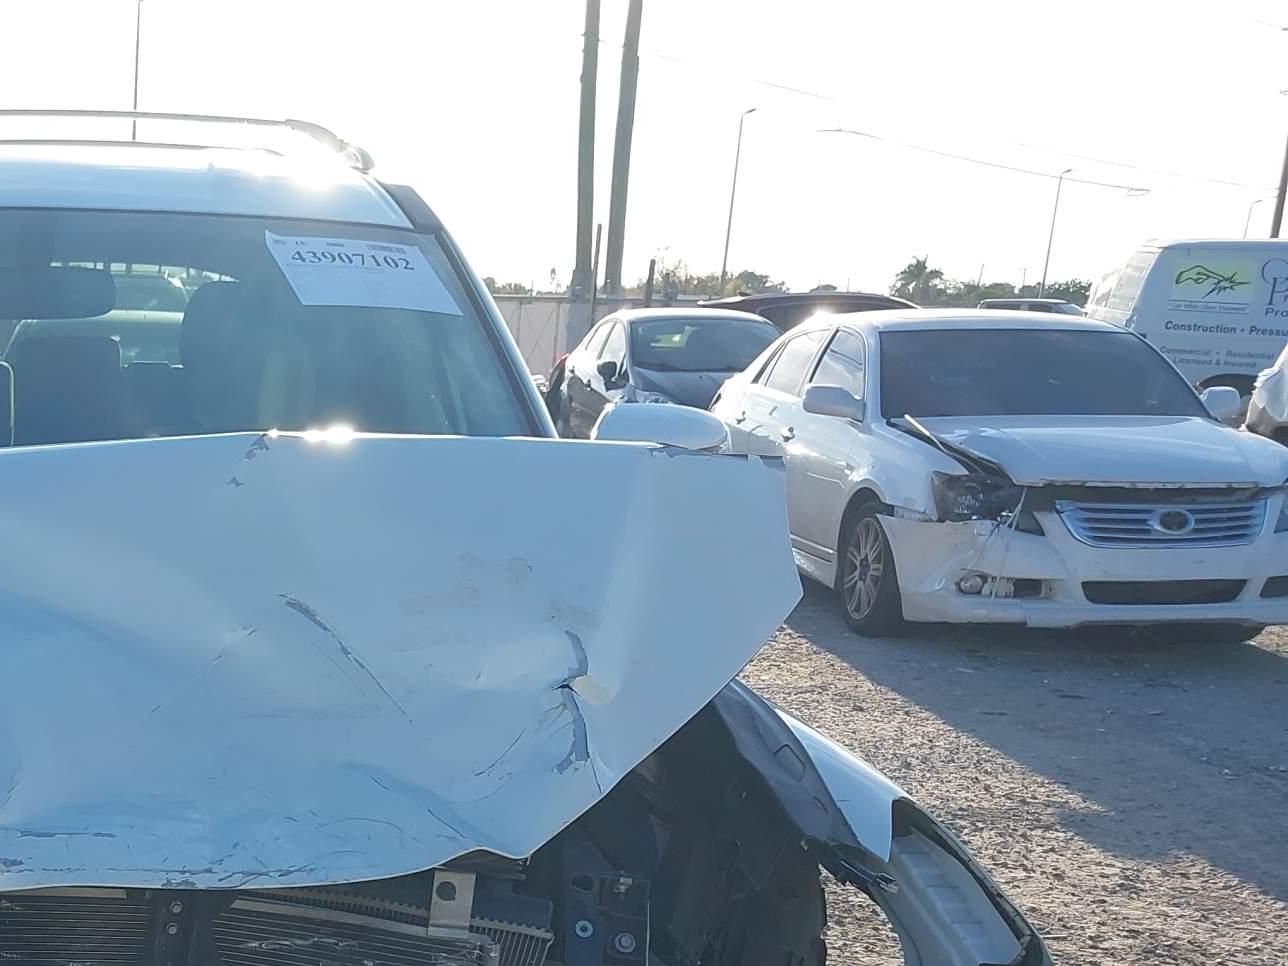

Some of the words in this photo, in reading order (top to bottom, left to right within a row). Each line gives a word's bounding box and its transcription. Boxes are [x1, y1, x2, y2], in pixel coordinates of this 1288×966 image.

[291, 250, 415, 271] 43907102
[1165, 320, 1237, 335] Construction
[1160, 346, 1212, 357] Commercial
